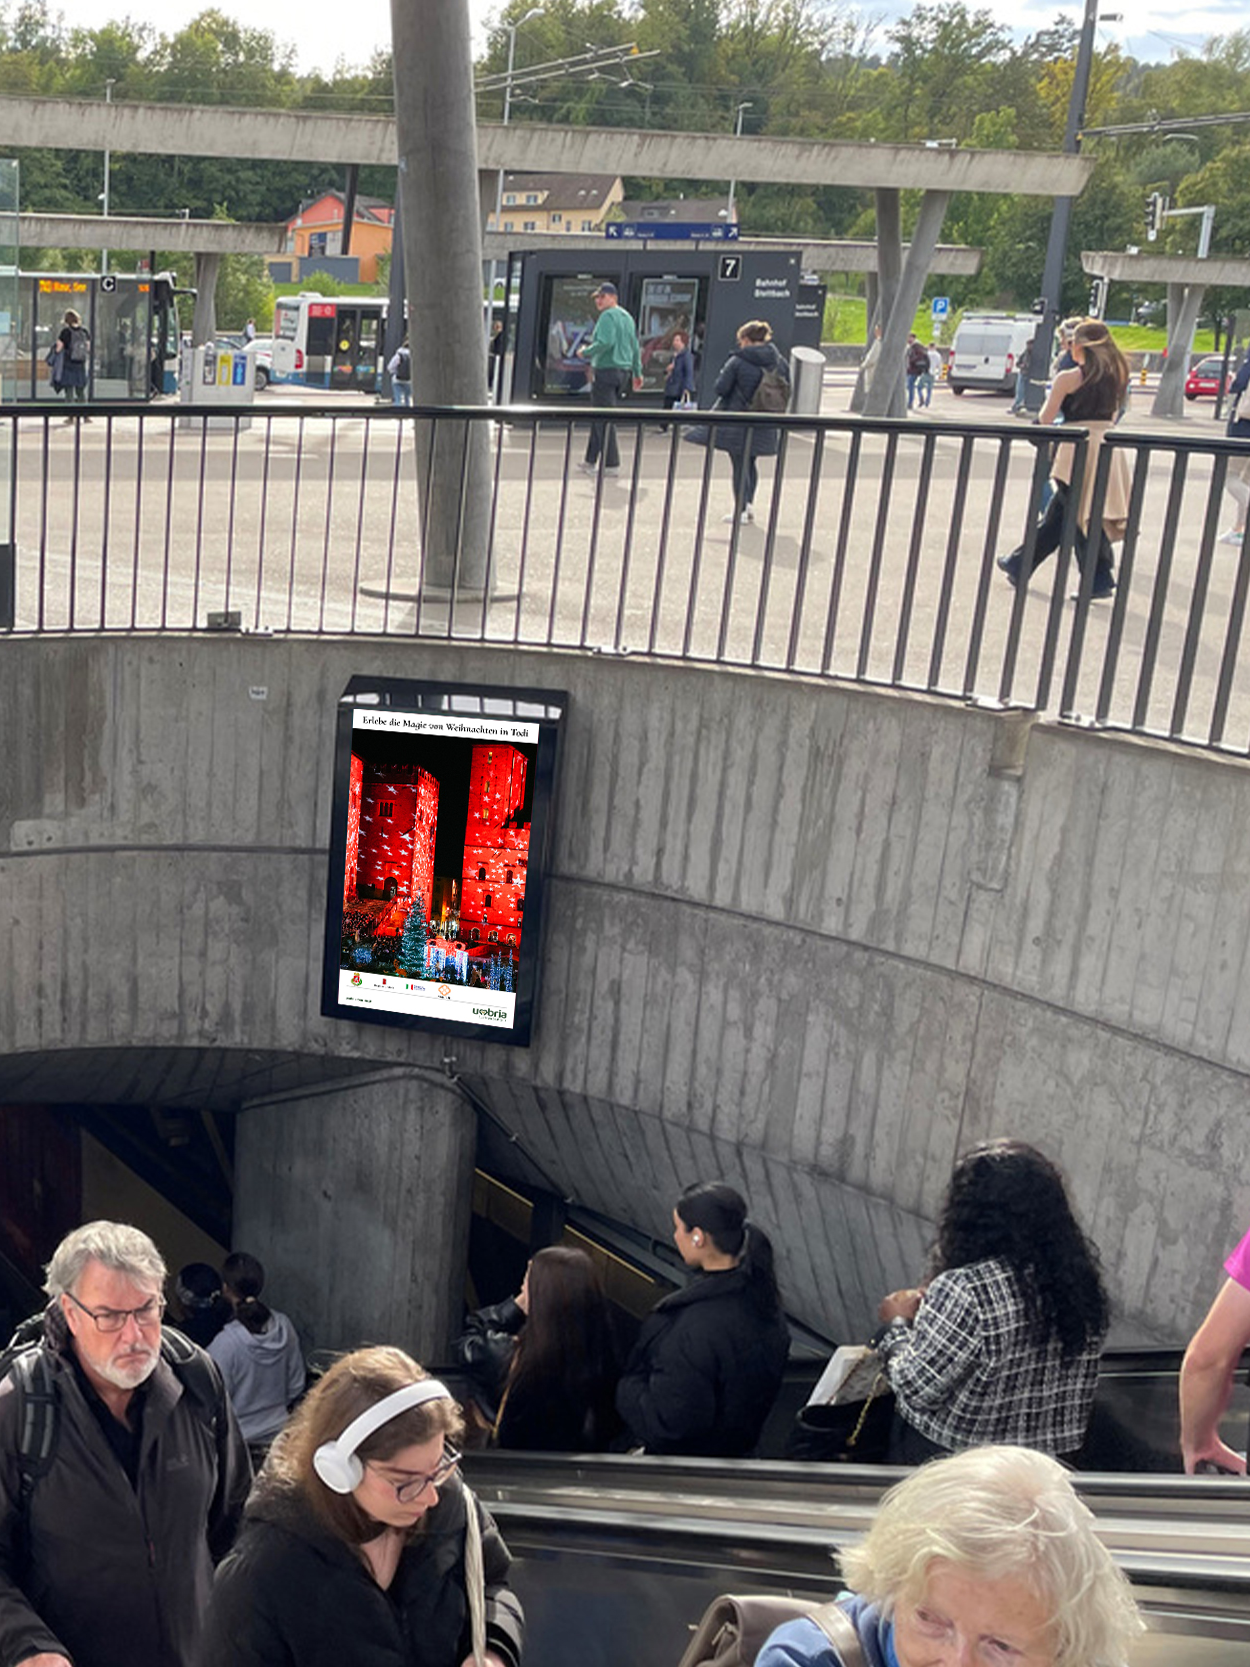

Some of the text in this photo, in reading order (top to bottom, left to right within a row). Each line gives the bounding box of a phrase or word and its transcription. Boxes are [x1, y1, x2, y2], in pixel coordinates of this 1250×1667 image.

[724, 259, 736, 277] 7
[102, 278, 115, 291] C
[755, 278, 788, 288] Bahnhof
[754, 288, 791, 298] Stettbach
[935, 300, 946, 314] P
[362, 715, 529, 738] Erlebe die Magie von Weihnachten in Todi
